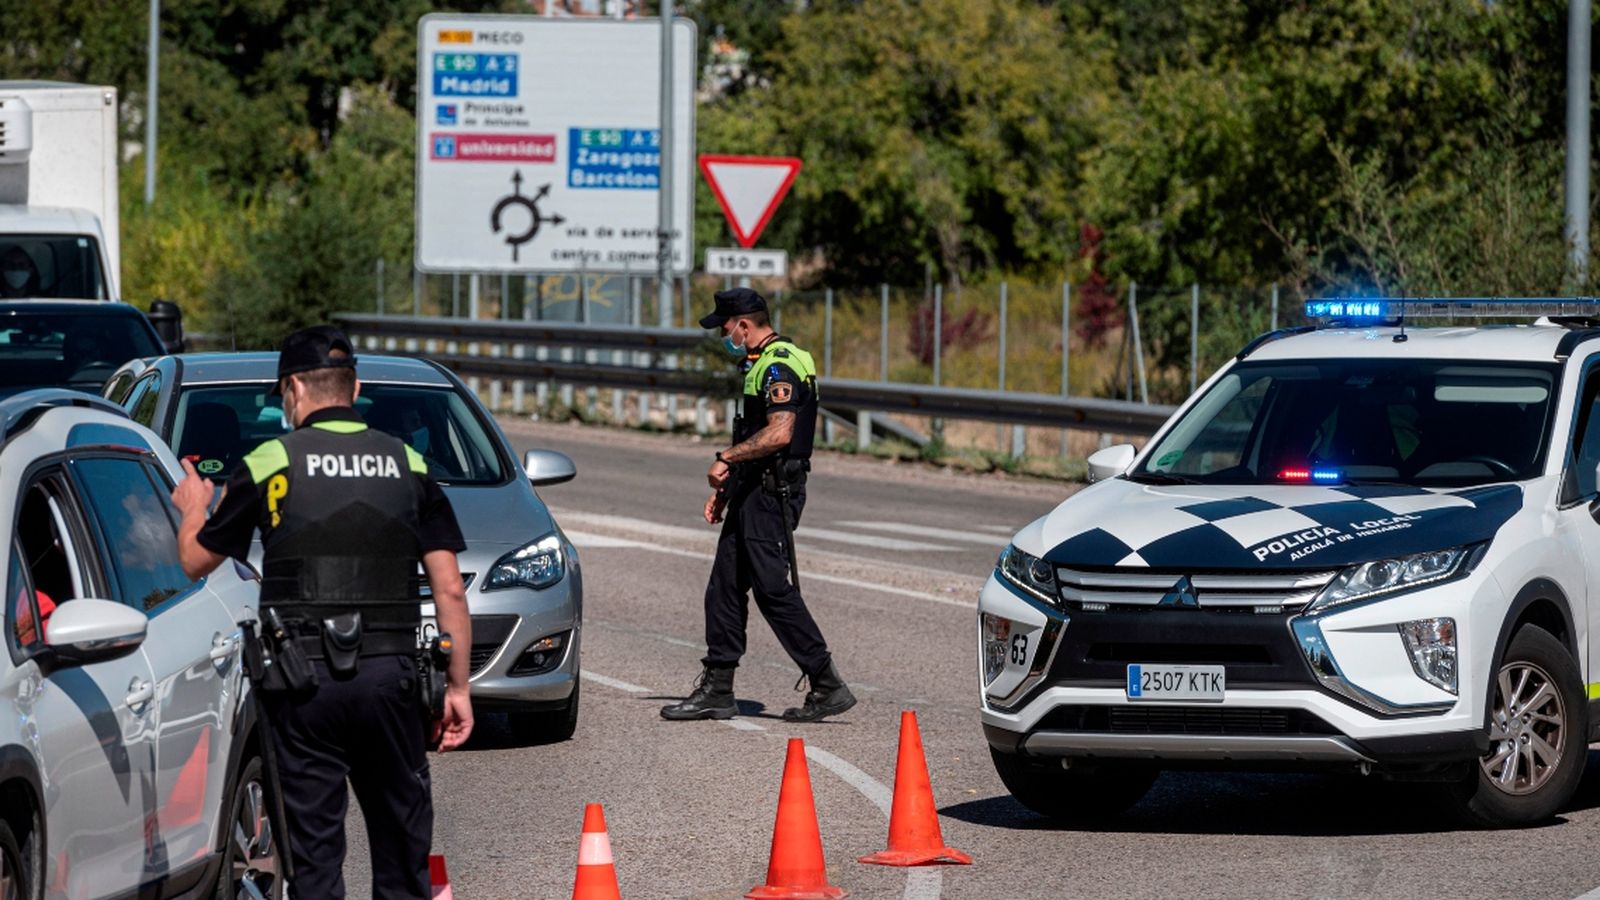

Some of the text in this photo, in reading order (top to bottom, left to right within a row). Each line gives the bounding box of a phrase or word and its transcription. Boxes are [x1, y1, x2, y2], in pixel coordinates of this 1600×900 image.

[478, 31, 524, 45] MECO
[436, 55, 516, 72] E 90 A 2
[440, 76, 510, 94] Madrid
[581, 129, 661, 147] E 90 A 2
[459, 140, 554, 157] universidad
[571, 168, 659, 187] Barcelon
[595, 226, 613, 238] de
[720, 256, 774, 270] 150 m
[306, 454, 401, 479] POLICIA
[1349, 514, 1423, 530] LOCAL
[1355, 521, 1413, 538] HENARES
[1011, 633, 1029, 666] 63
[1142, 672, 1184, 692] 2507
[1189, 672, 1221, 693] KTK
